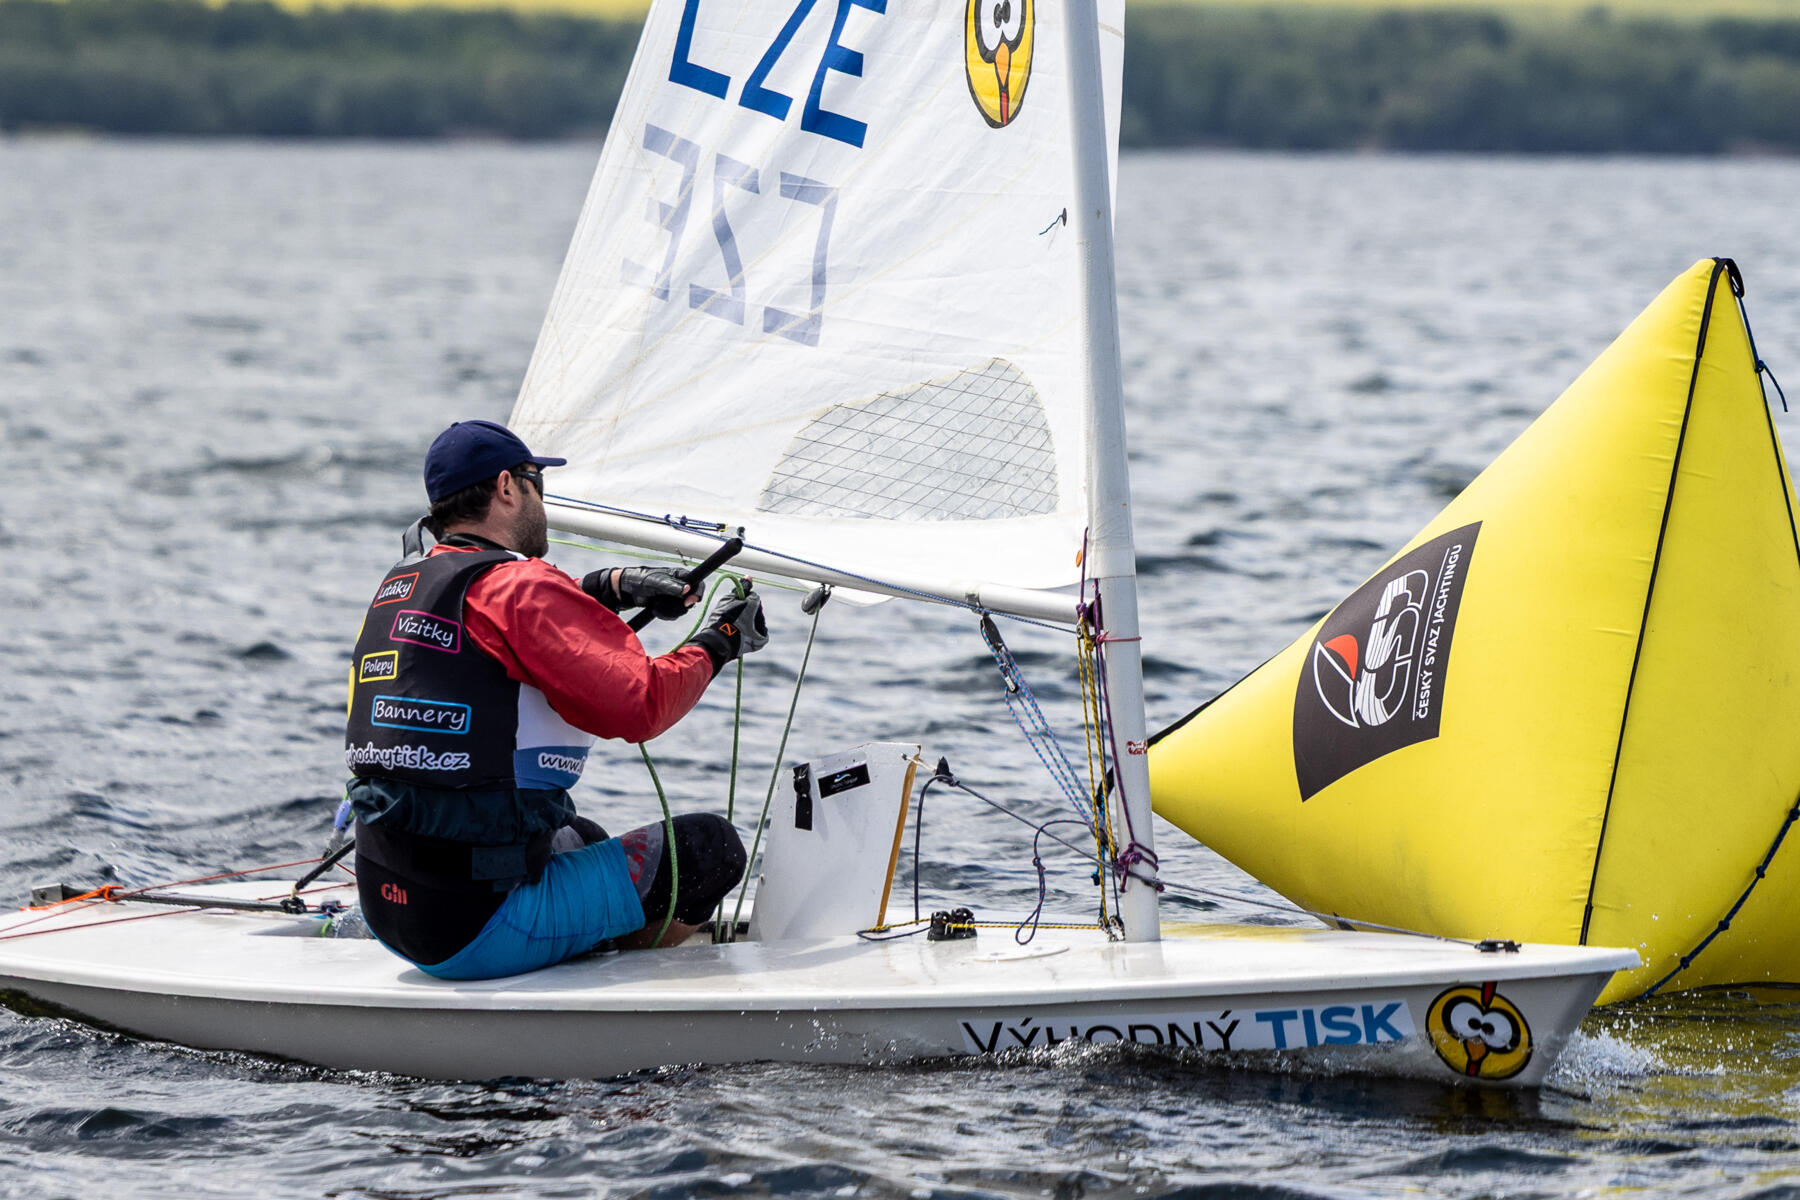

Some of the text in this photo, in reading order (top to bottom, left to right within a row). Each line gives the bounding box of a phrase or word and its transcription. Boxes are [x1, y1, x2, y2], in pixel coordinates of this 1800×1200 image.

[398, 617, 453, 647] Vizitky
[1416, 544, 1463, 719] ČESKÝ SVAZ JACHTINGU
[363, 659, 394, 675] Polepy
[374, 700, 466, 730] Bannery
[381, 883, 408, 905] Gill
[1255, 1003, 1404, 1049] TISK
